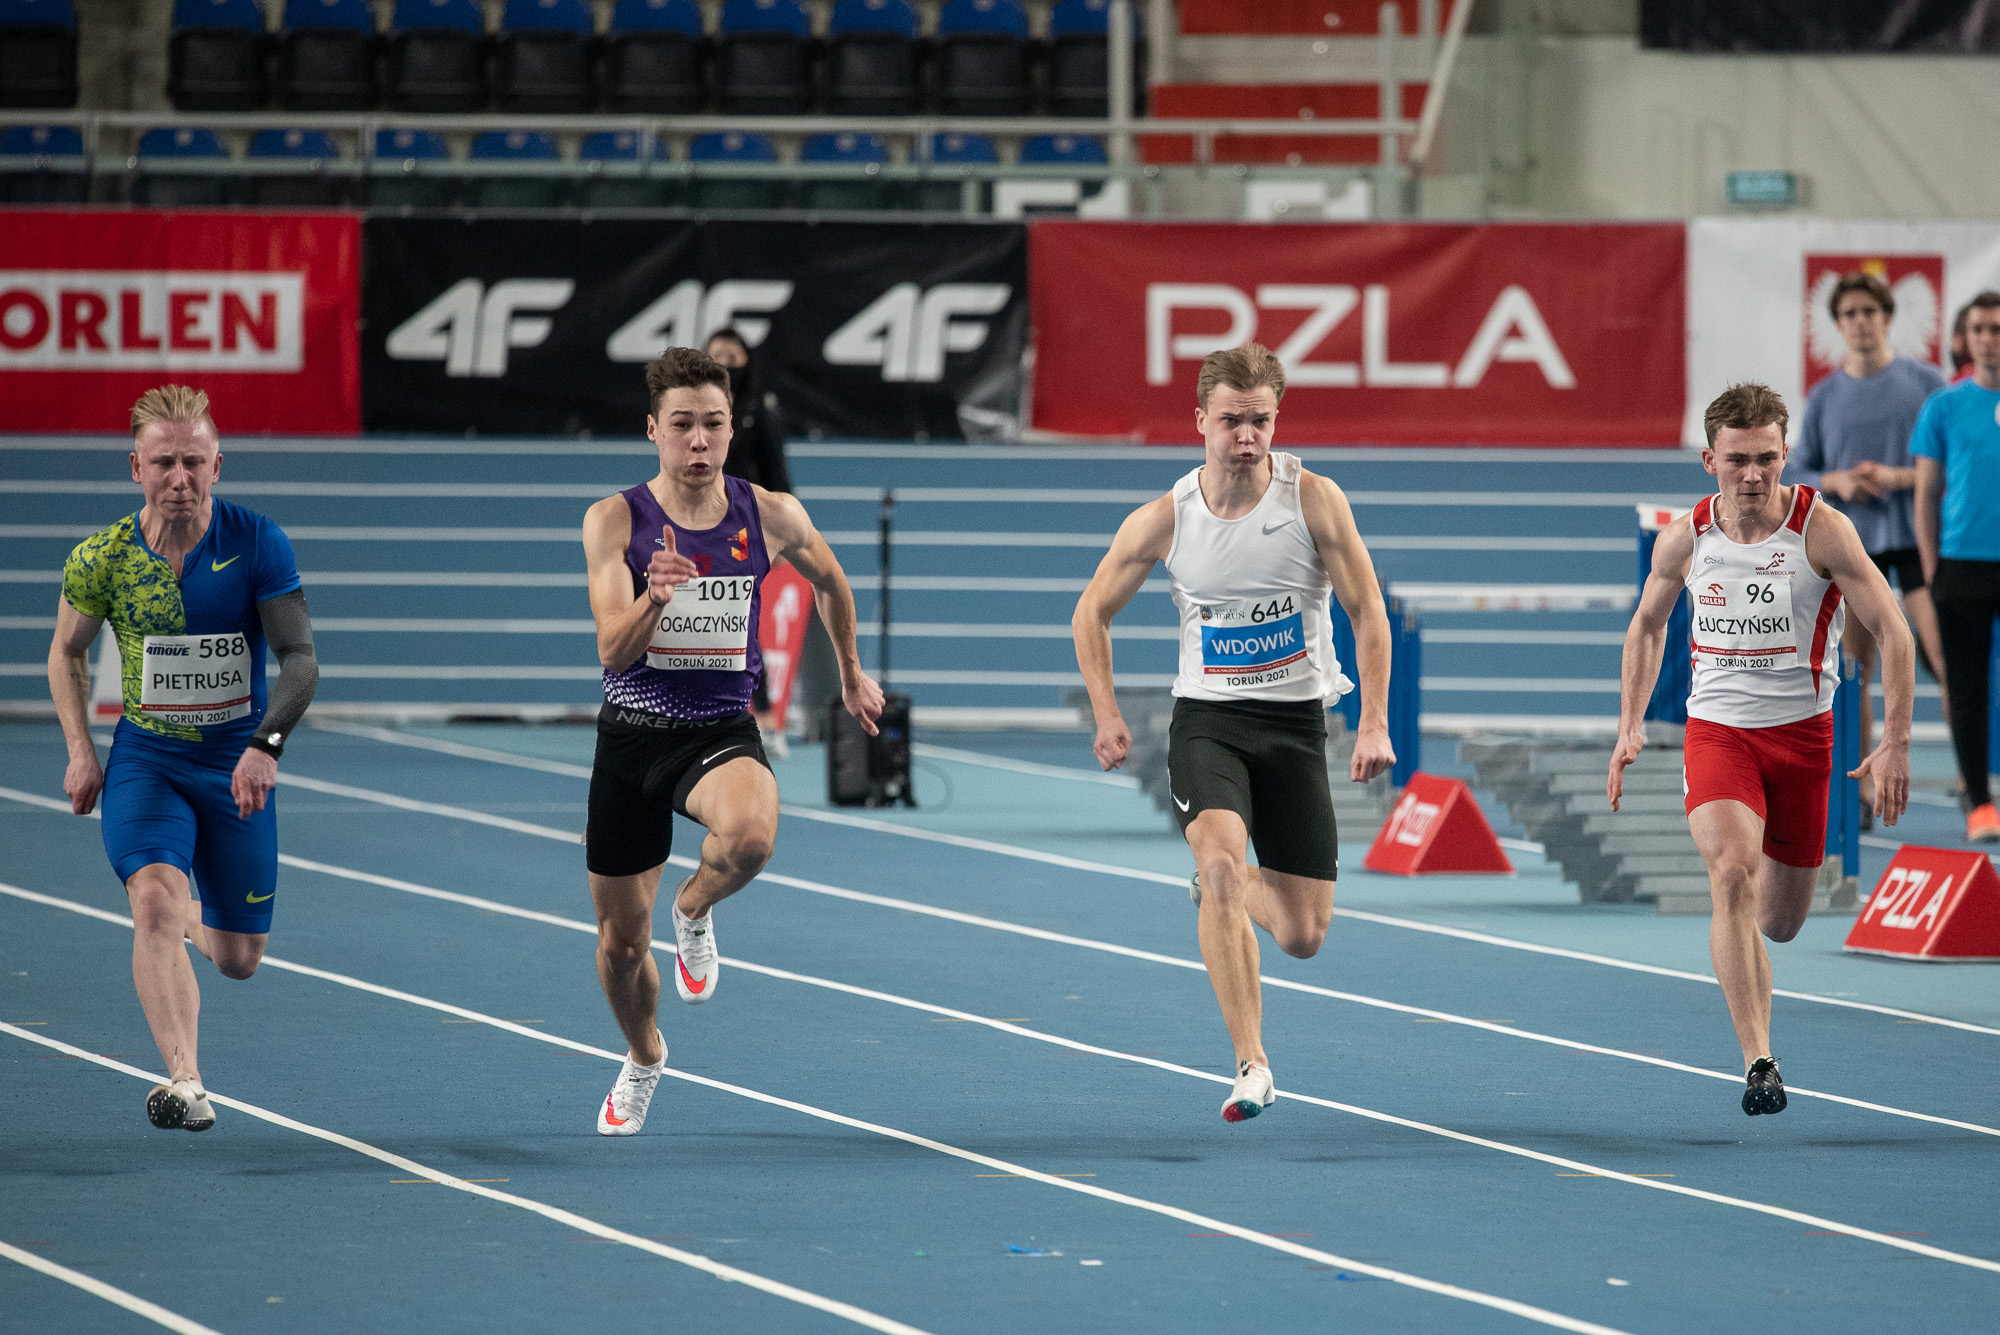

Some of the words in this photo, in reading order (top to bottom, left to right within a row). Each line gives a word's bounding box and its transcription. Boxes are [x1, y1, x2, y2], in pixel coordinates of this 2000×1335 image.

[0, 290, 277, 351] ORLEN
[385, 277, 575, 377] 4F
[822, 281, 1012, 382] 4F
[1144, 282, 1577, 388] PZLA
[698, 580, 752, 600] 1019
[1746, 583, 1774, 604] 96
[1251, 596, 1294, 623] 644
[1700, 596, 1725, 605] ORLEN
[657, 612, 748, 633] OGACZYŃSK
[1699, 615, 1790, 634] ŁUCZYŃSKI
[146, 646, 190, 656] 4MOVE
[199, 637, 244, 658] 588
[1211, 627, 1295, 655] WDOWIK
[668, 656, 704, 667] TORUŃ
[708, 658, 732, 667] 2021
[1715, 657, 1746, 667] TORUŃ
[1750, 658, 1774, 667] 2021
[153, 670, 243, 690] PIETRUSA
[1226, 673, 1263, 686] TORUŃ
[1267, 668, 1289, 682] 2021
[165, 711, 203, 723] TORUŃ
[207, 711, 230, 722] 2021
[616, 710, 672, 728] NIKE
[1863, 867, 1954, 931] PZLA
